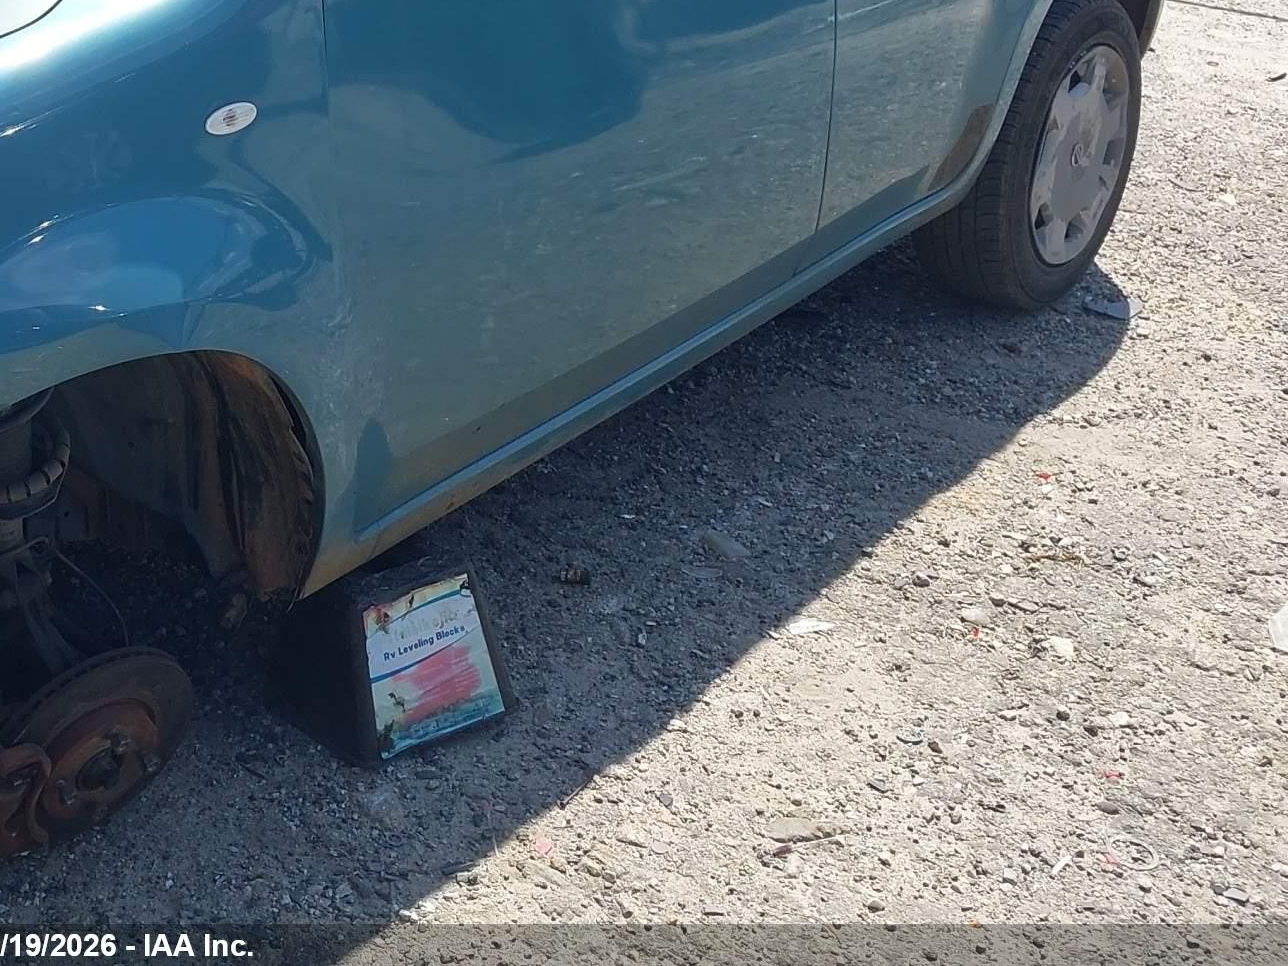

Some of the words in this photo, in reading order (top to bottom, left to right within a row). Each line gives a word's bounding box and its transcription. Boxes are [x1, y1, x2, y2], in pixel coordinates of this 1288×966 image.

[383, 651, 396, 663] Rv
[397, 636, 435, 656] Leveling
[435, 624, 467, 641] Blocks
